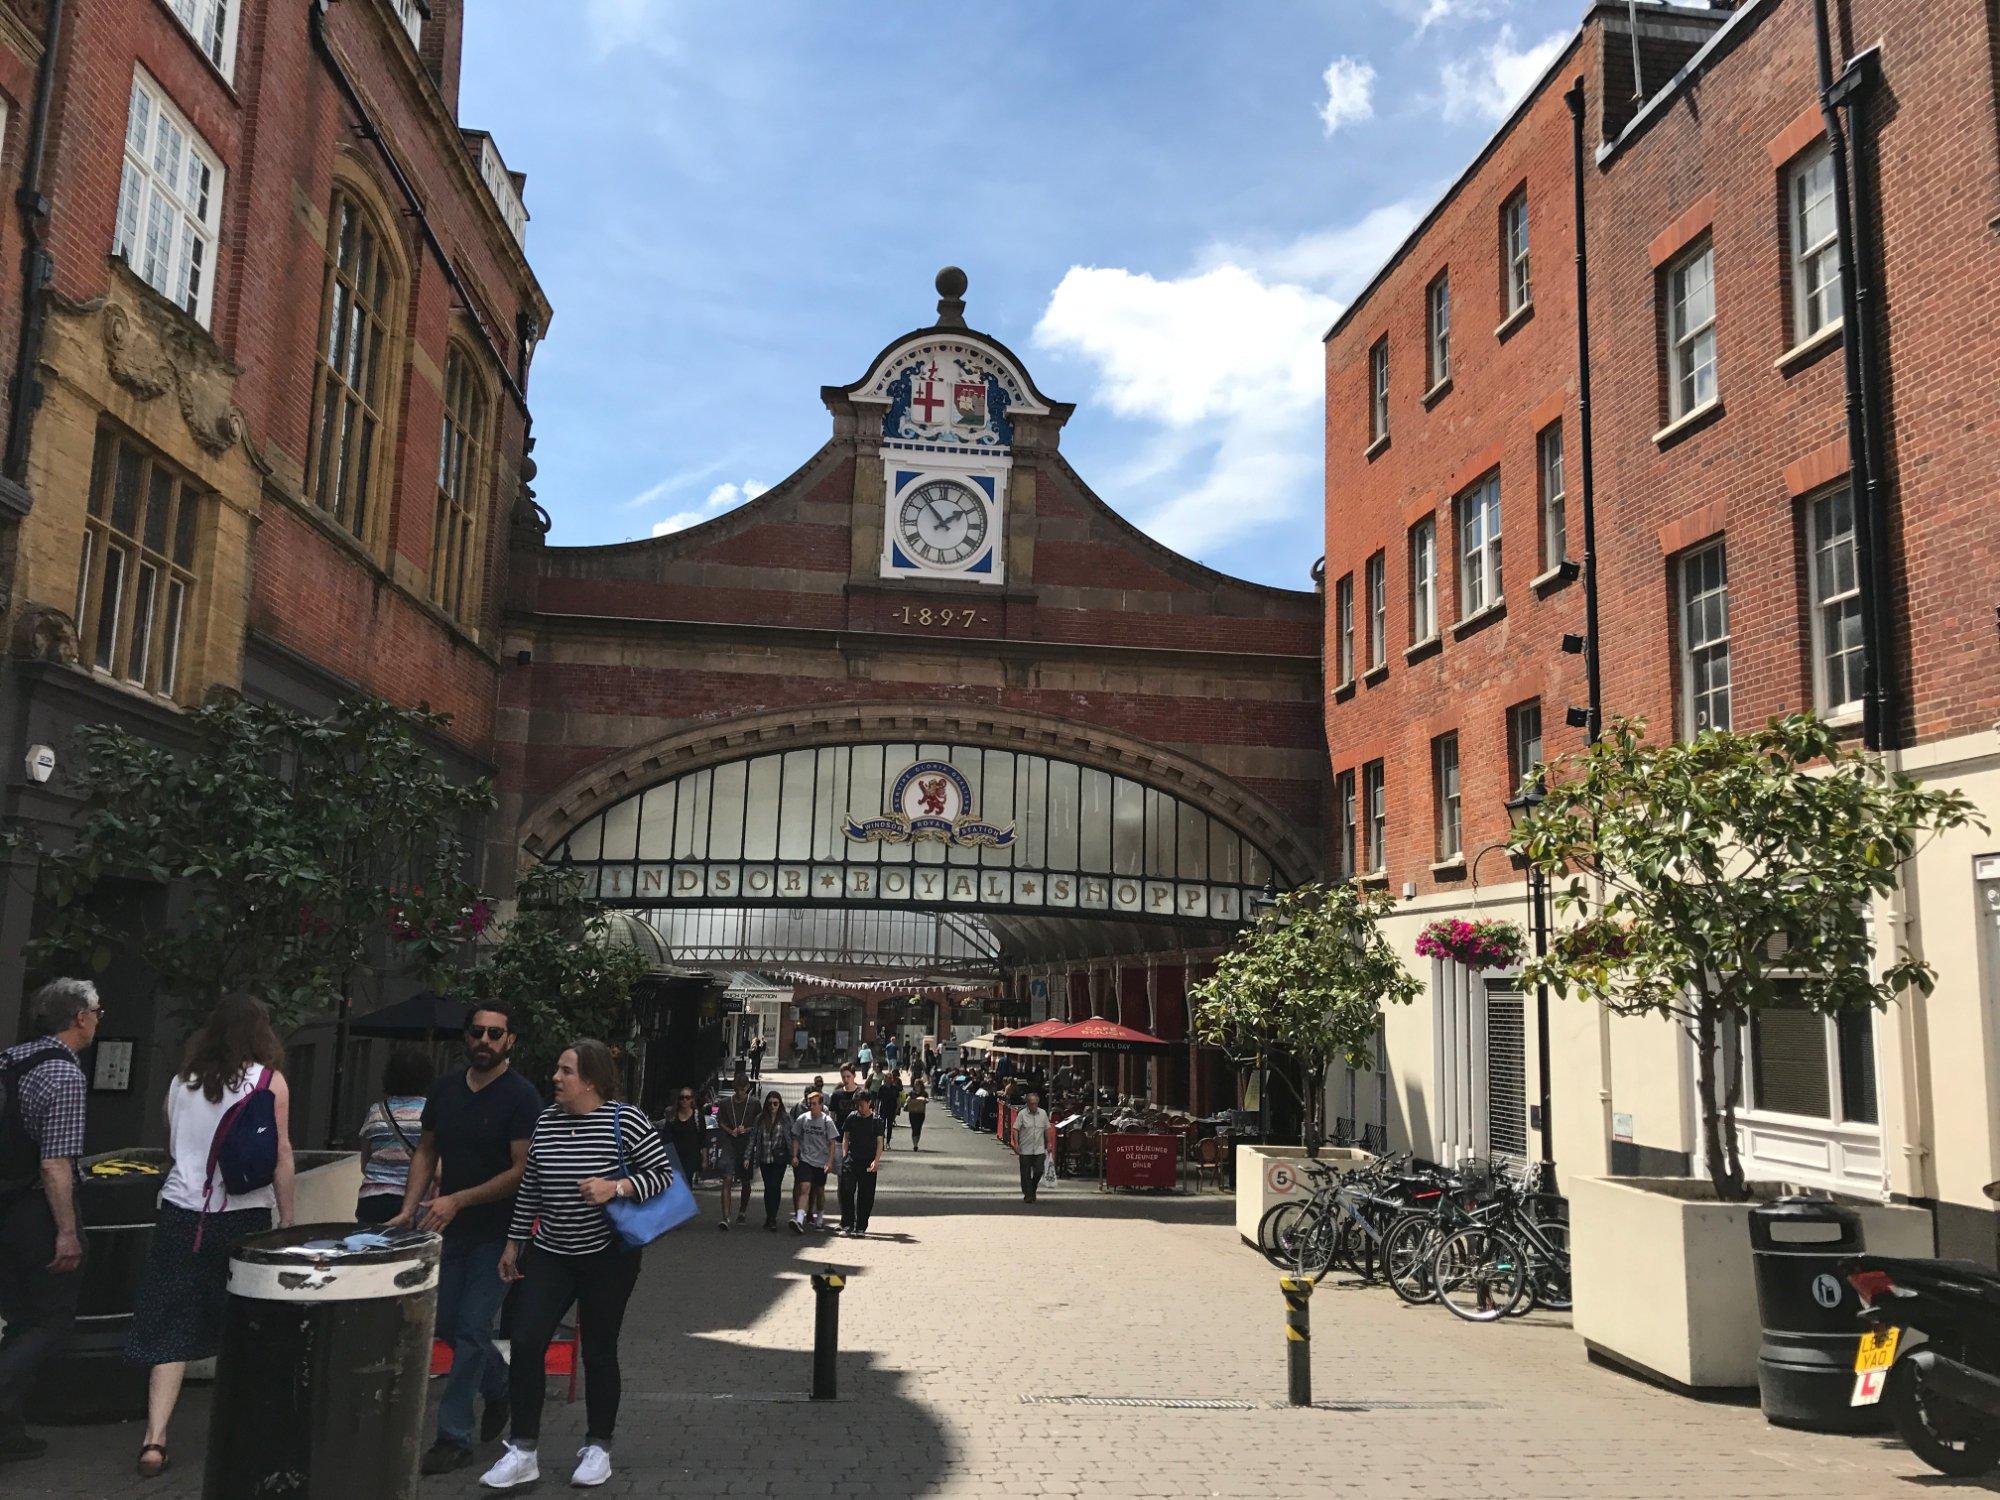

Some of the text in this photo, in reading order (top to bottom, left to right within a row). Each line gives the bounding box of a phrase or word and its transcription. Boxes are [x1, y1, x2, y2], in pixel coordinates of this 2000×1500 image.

[864, 820, 1000, 837] WINDSOR ROYAL STATION
[853, 871, 1003, 897] ROYAL
[1116, 1145, 1134, 1153] PETIT
[1276, 1171, 1288, 1185] 5
[1860, 1373, 1875, 1396] L
